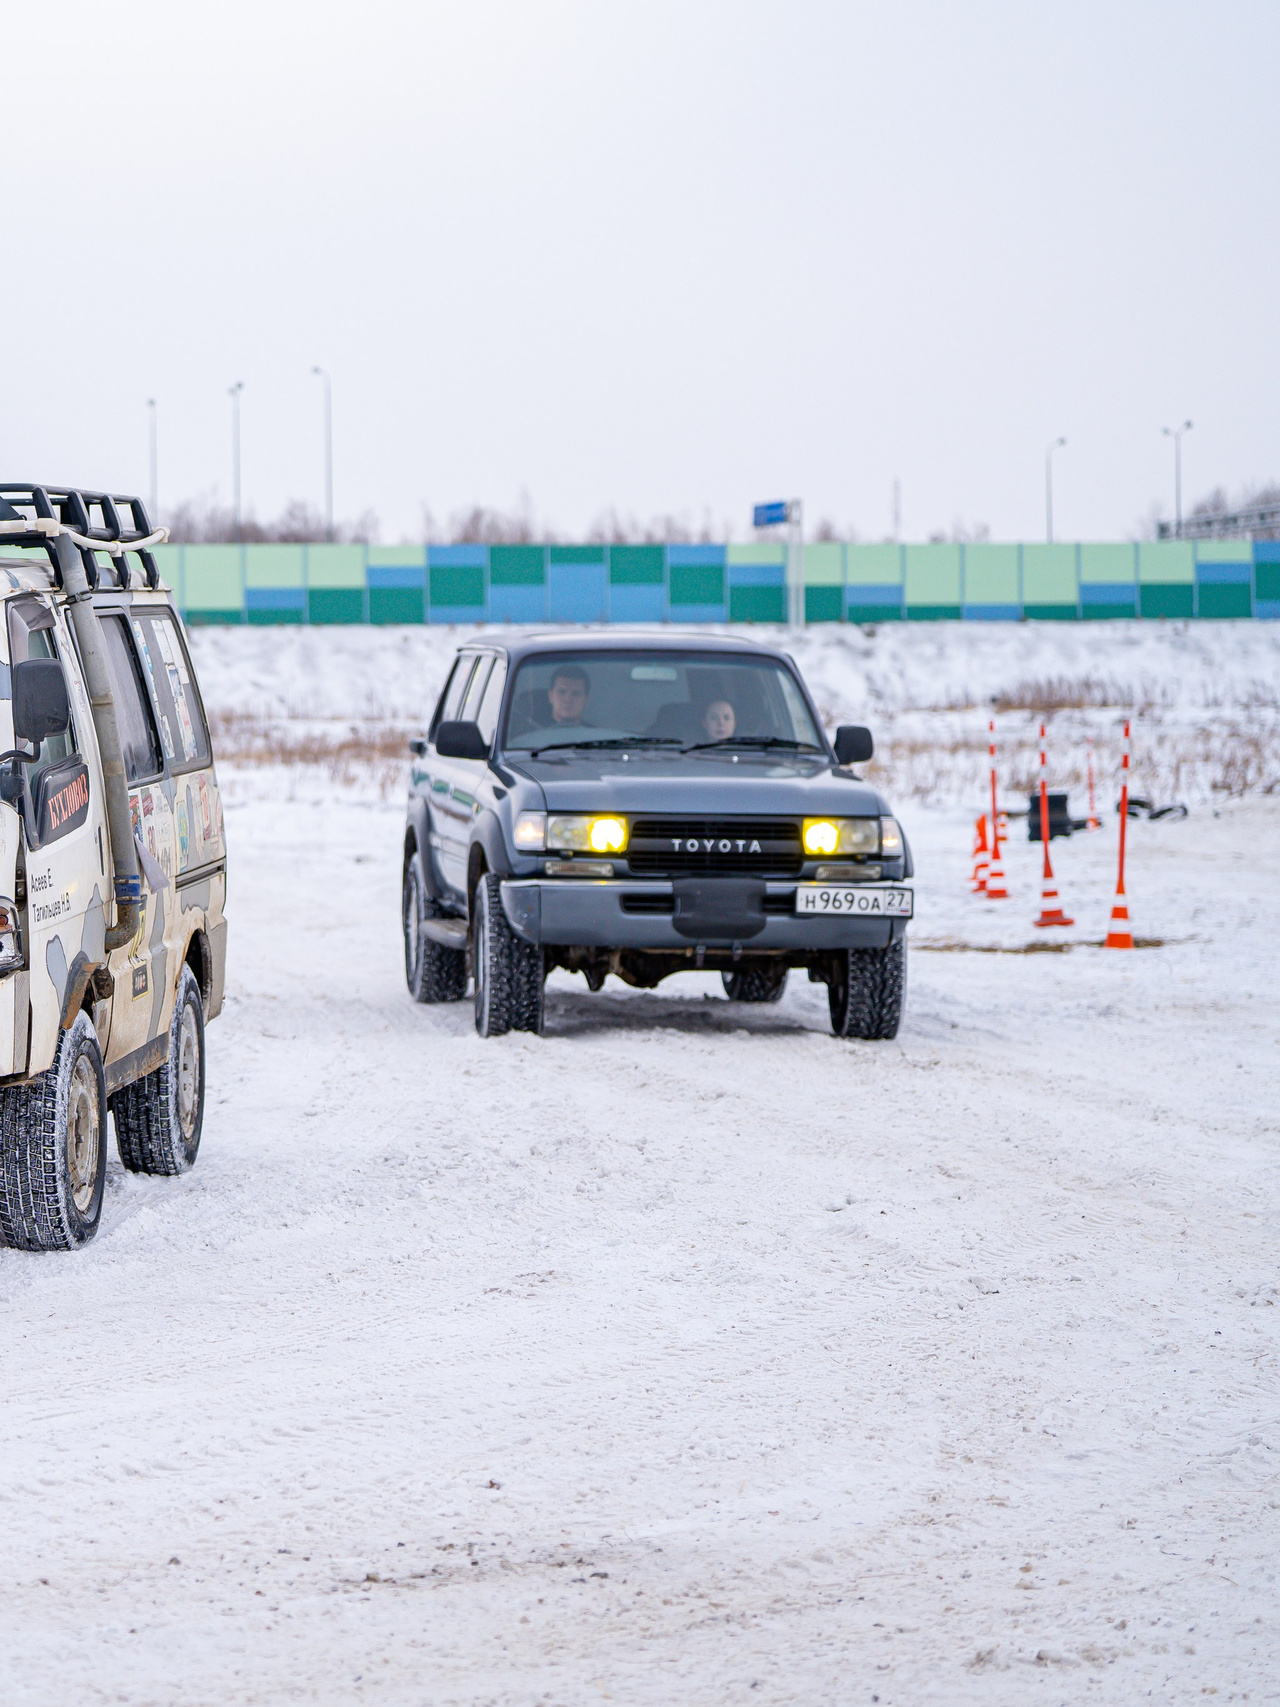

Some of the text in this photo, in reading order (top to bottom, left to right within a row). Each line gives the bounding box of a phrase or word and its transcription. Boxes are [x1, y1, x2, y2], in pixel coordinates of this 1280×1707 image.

[48, 773, 89, 830] БУХЛОВОЗ
[671, 838, 762, 854] TOYOTA
[31, 874, 47, 893] Асеев
[805, 891, 905, 911] Н969ОА 27
